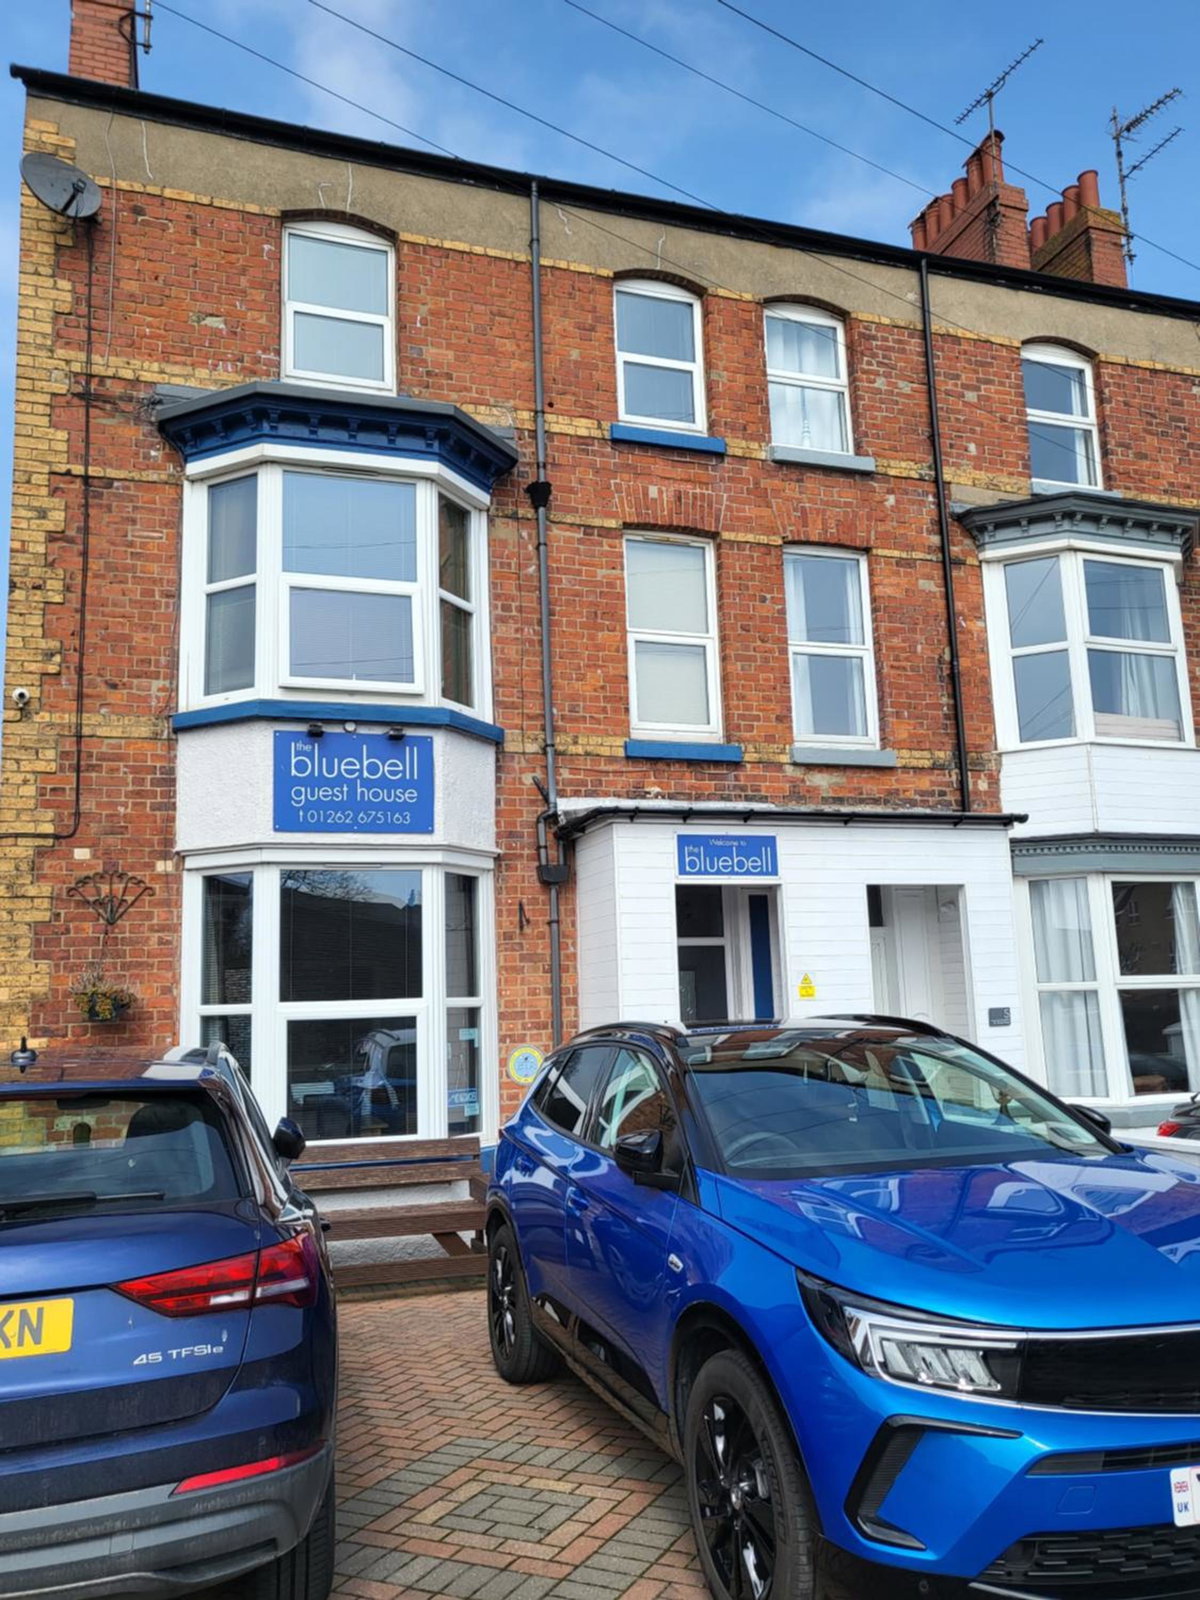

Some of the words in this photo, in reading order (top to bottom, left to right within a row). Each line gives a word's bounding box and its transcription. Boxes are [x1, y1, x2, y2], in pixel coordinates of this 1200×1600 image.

[296, 740, 312, 752] the
[291, 742, 417, 780] bluebell
[291, 783, 348, 807] guest
[357, 779, 417, 802] house
[307, 810, 353, 824] 01262
[358, 810, 411, 824] 675163
[687, 844, 699, 853] the
[709, 838, 739, 847] Welcome
[740, 839, 748, 847] to
[684, 845, 772, 873] bluebell
[133, 1352, 162, 1366] 45
[1177, 1502, 1190, 1513] UK
